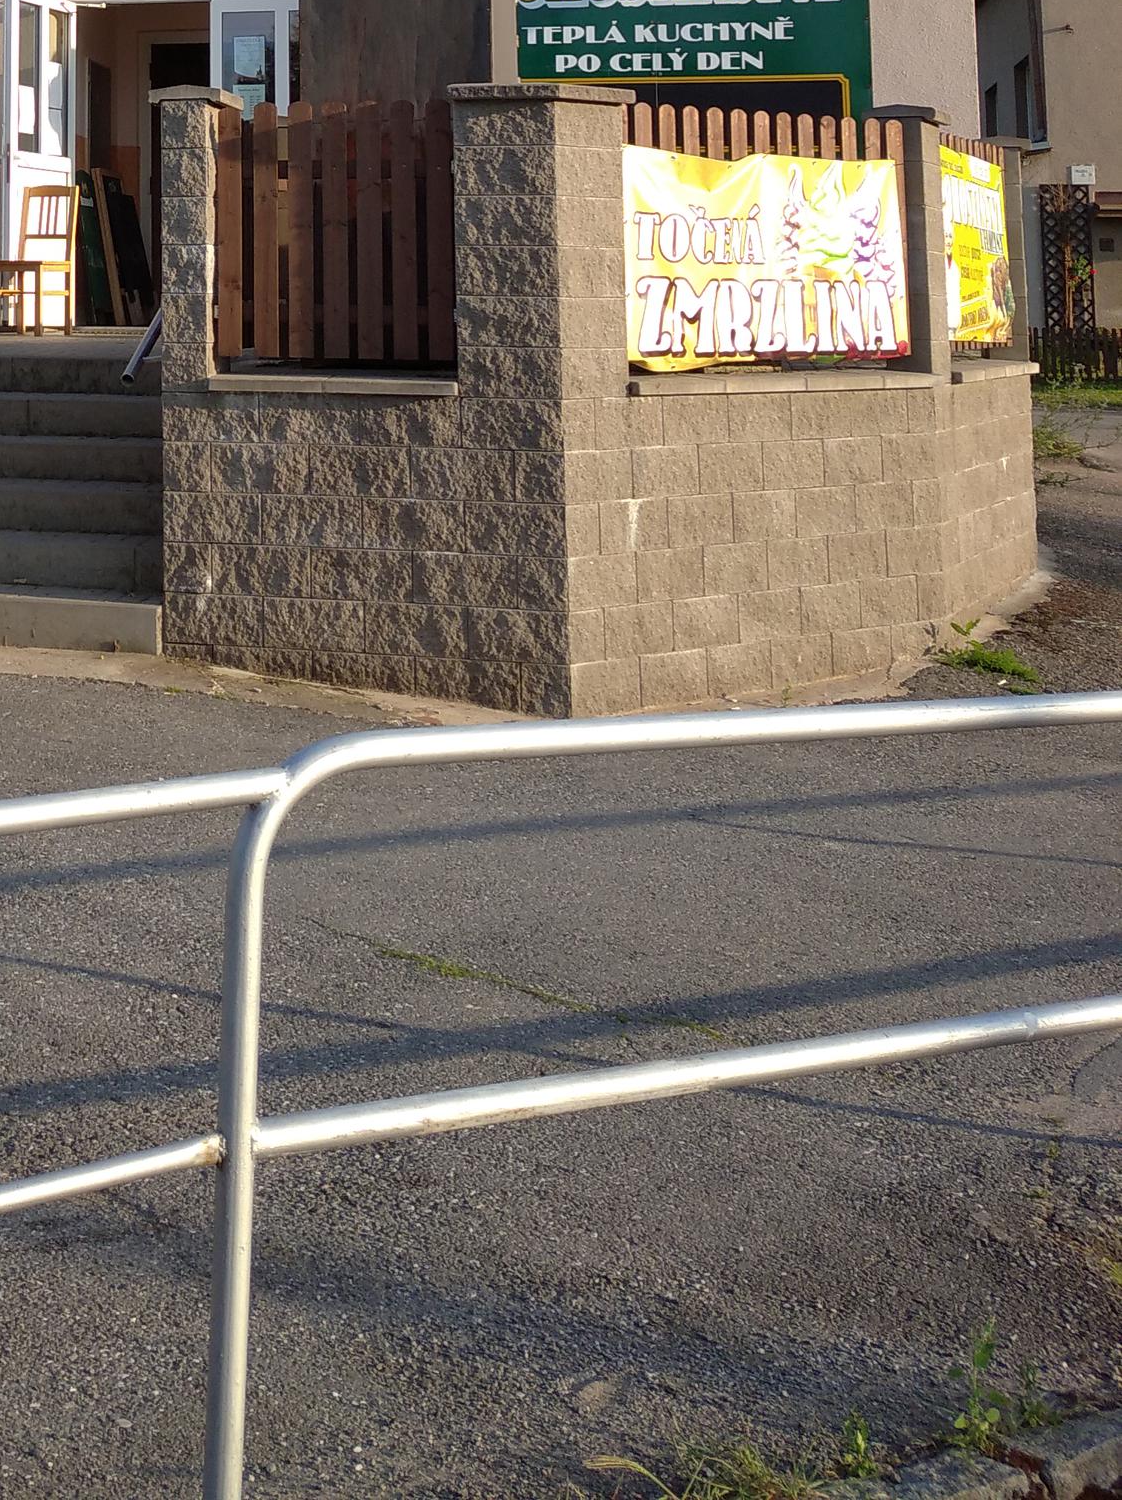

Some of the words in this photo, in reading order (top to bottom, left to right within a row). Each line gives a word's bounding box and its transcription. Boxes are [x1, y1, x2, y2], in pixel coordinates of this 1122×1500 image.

[521, 20, 626, 45] TEPLÁ
[634, 16, 795, 43] KUCHYNĚ
[555, 53, 601, 73] PO
[609, 48, 690, 72] CELÝ
[696, 51, 764, 71] DEN
[634, 203, 766, 265] TOČENÁ
[636, 275, 901, 358] ZMRZLINA
